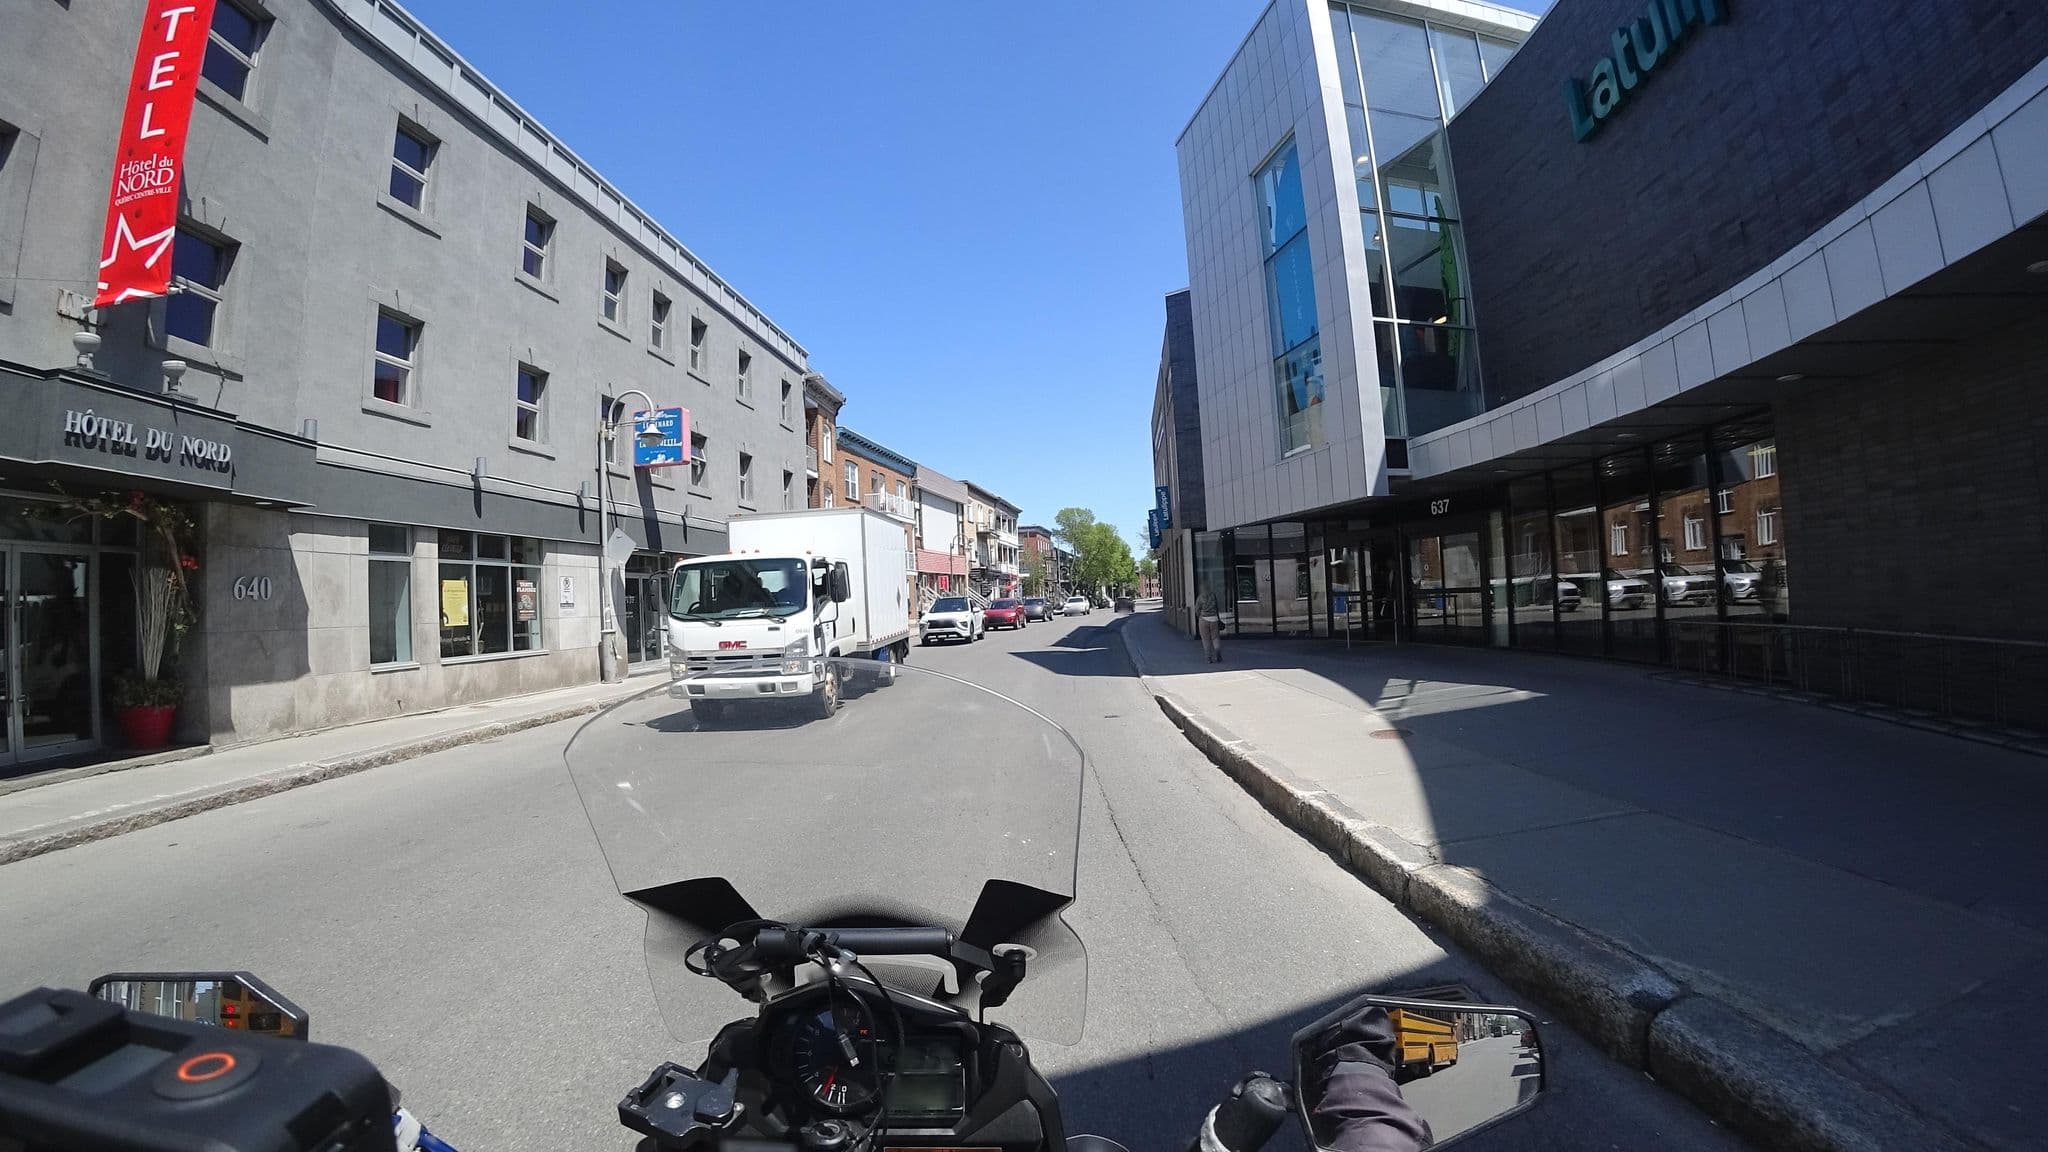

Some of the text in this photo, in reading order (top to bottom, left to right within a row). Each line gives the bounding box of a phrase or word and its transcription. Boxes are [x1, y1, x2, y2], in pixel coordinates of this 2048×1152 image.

[120, 153, 174, 178] Hôtel du
[116, 168, 175, 197] NORD
[64, 409, 232, 462] HÔTEL DU NORD
[1430, 498, 1450, 515] 637
[233, 576, 272, 600] 640
[718, 641, 747, 649] GMC
